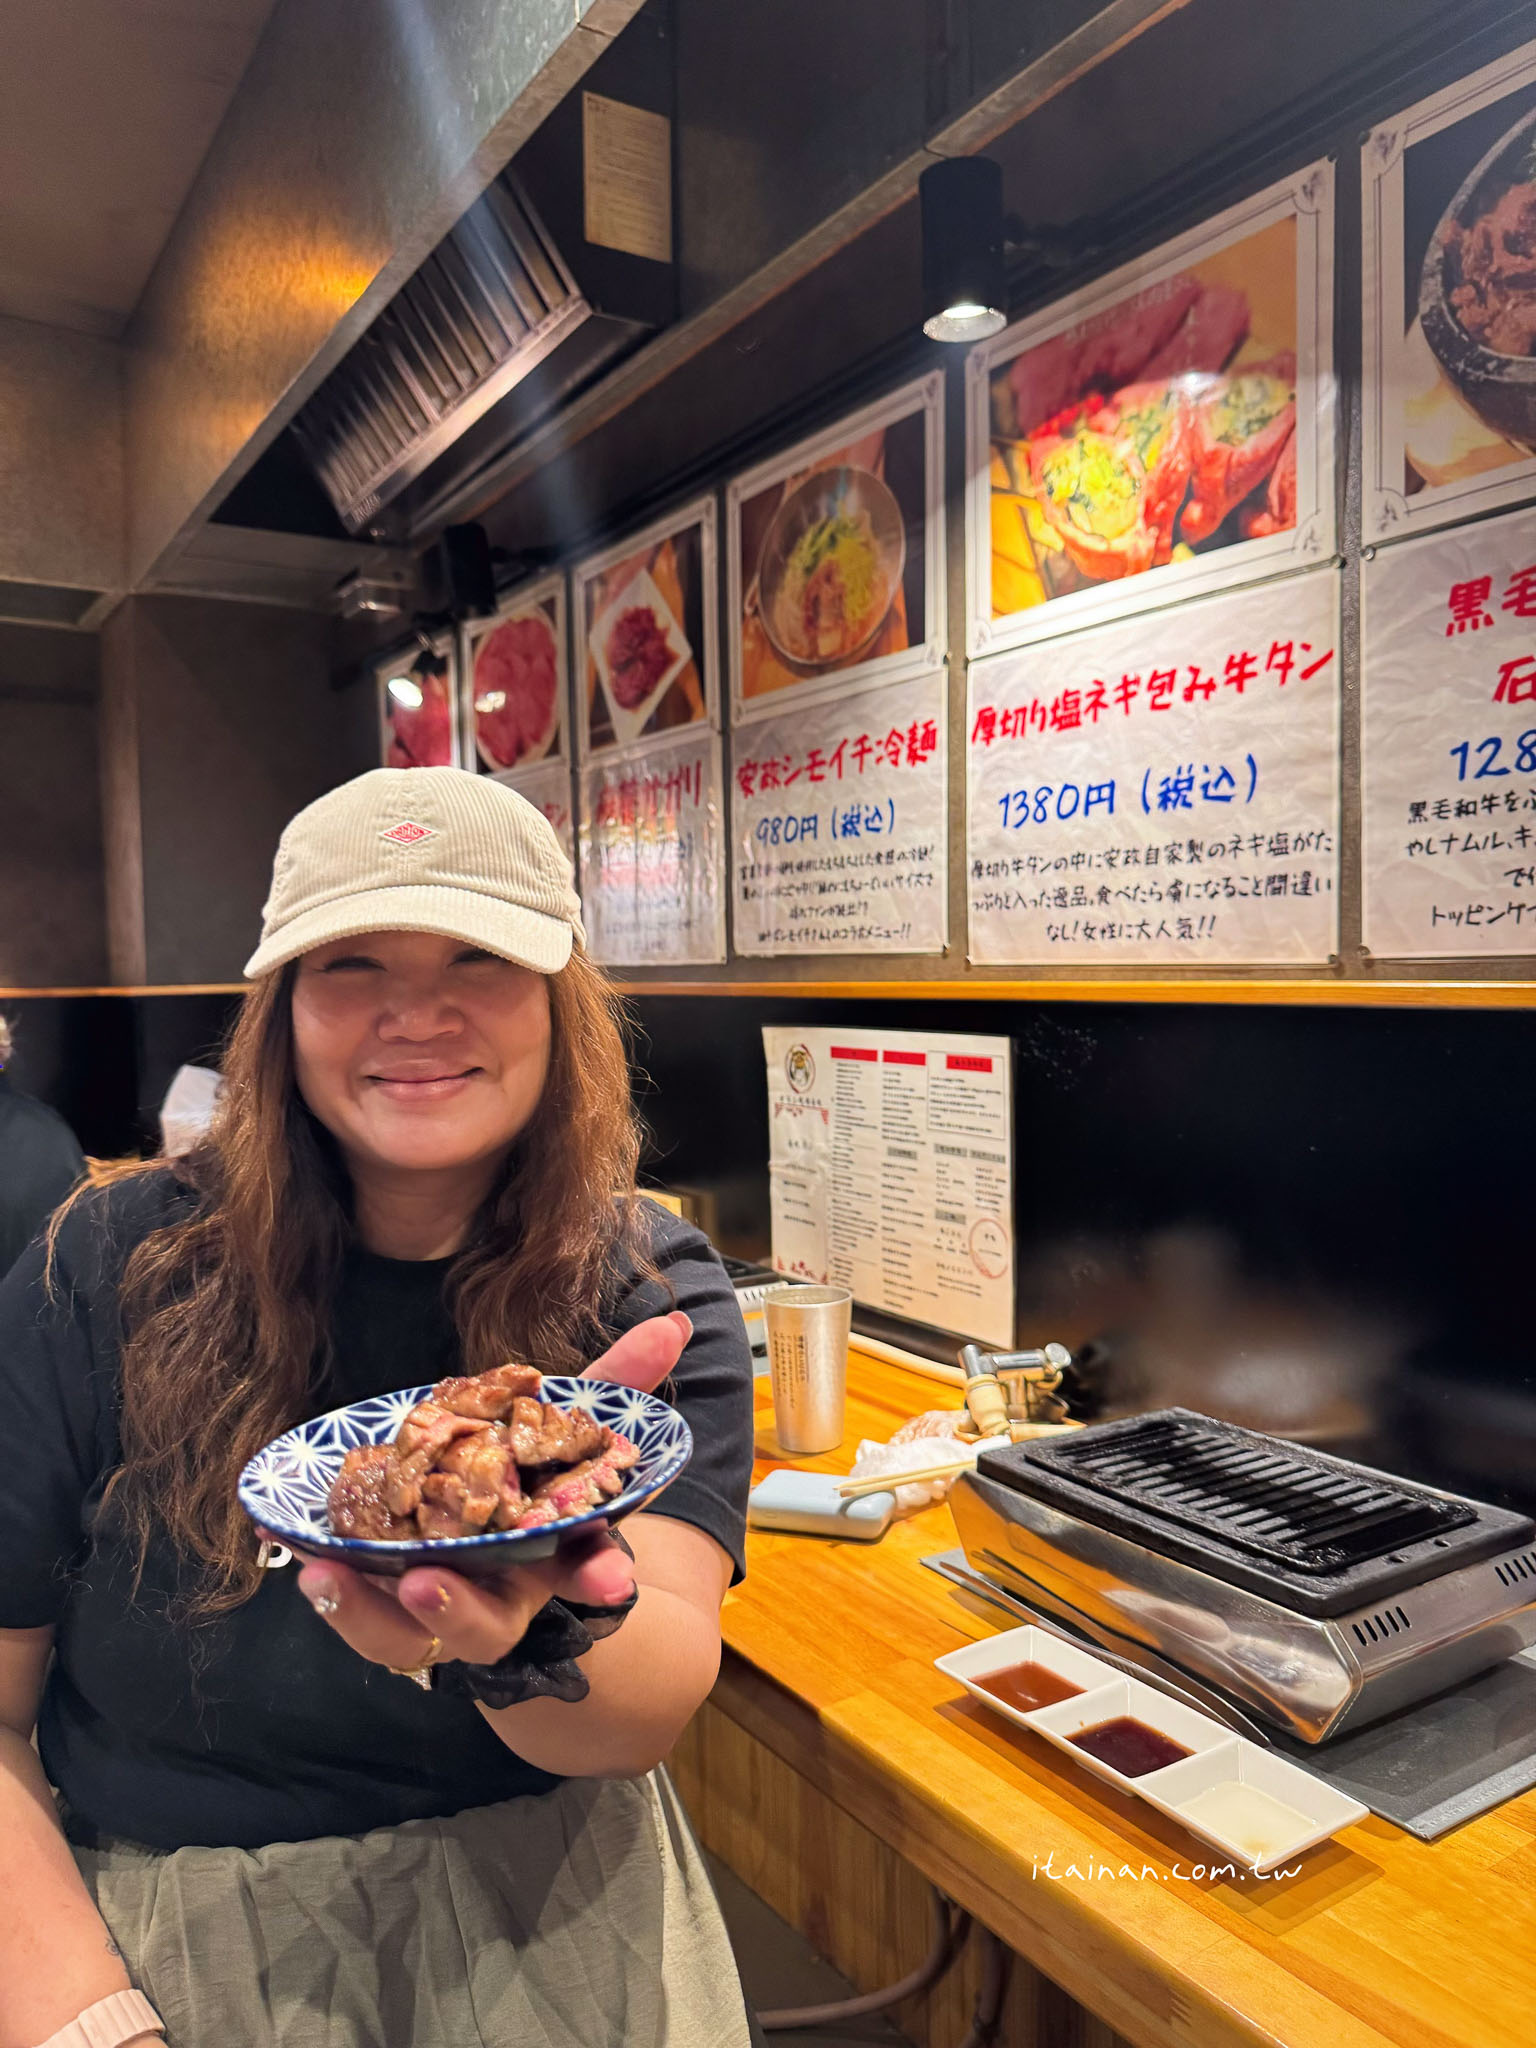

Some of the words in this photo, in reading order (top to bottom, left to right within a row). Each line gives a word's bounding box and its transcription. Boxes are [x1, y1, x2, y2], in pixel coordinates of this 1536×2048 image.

[970, 640, 1335, 748] 厚切り塩ネギ包み牛タン
